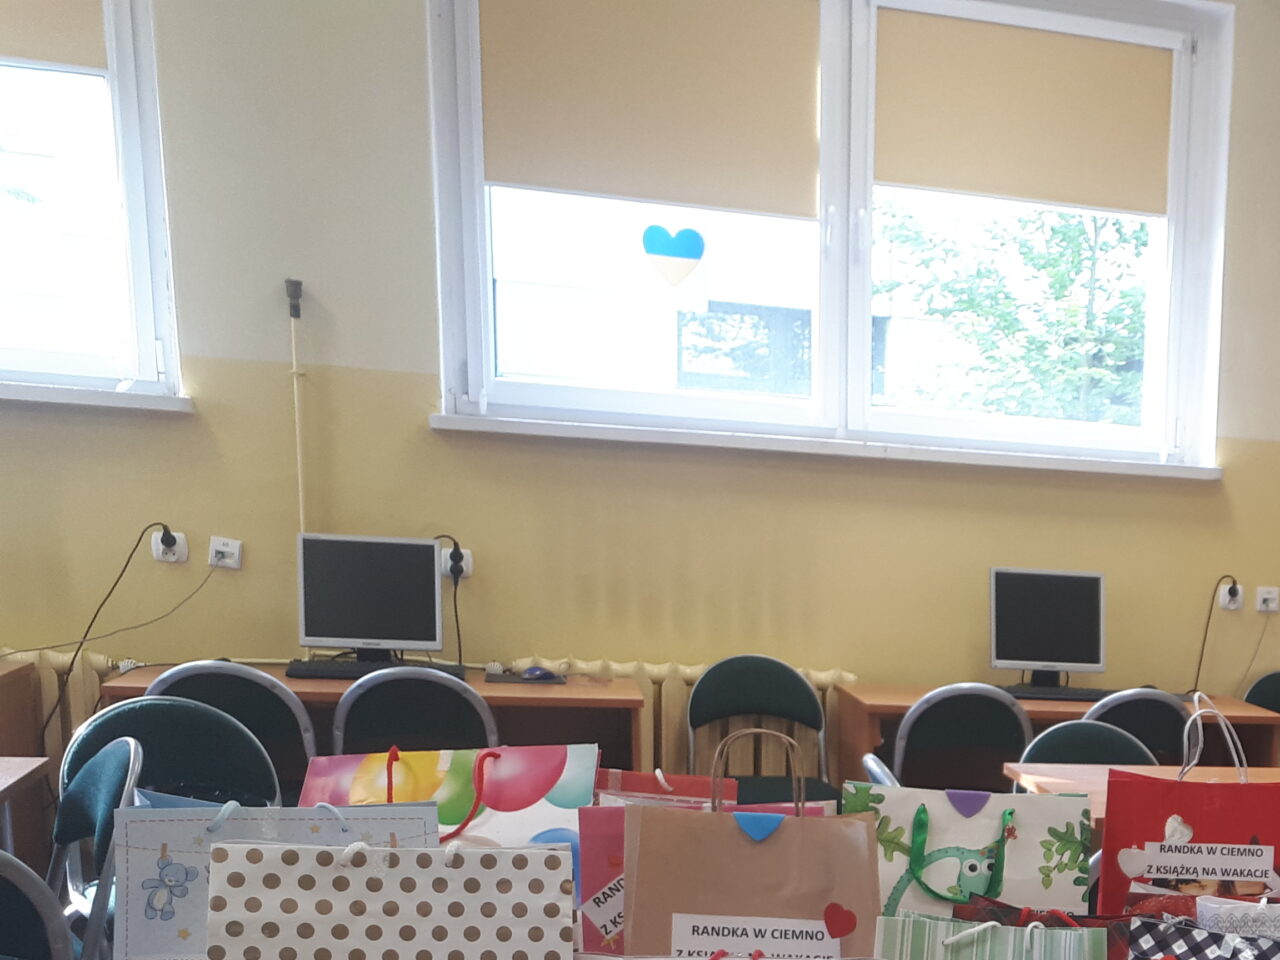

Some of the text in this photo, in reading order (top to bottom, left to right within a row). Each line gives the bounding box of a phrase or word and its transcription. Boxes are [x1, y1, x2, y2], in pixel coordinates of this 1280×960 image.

[1159, 844, 1264, 858] RANDKA W CIEMNO
[1146, 864, 1270, 879] Z KSIĄŻKĄ NA WAKACJE
[691, 925, 825, 942] RANDKA W CIEMNO
